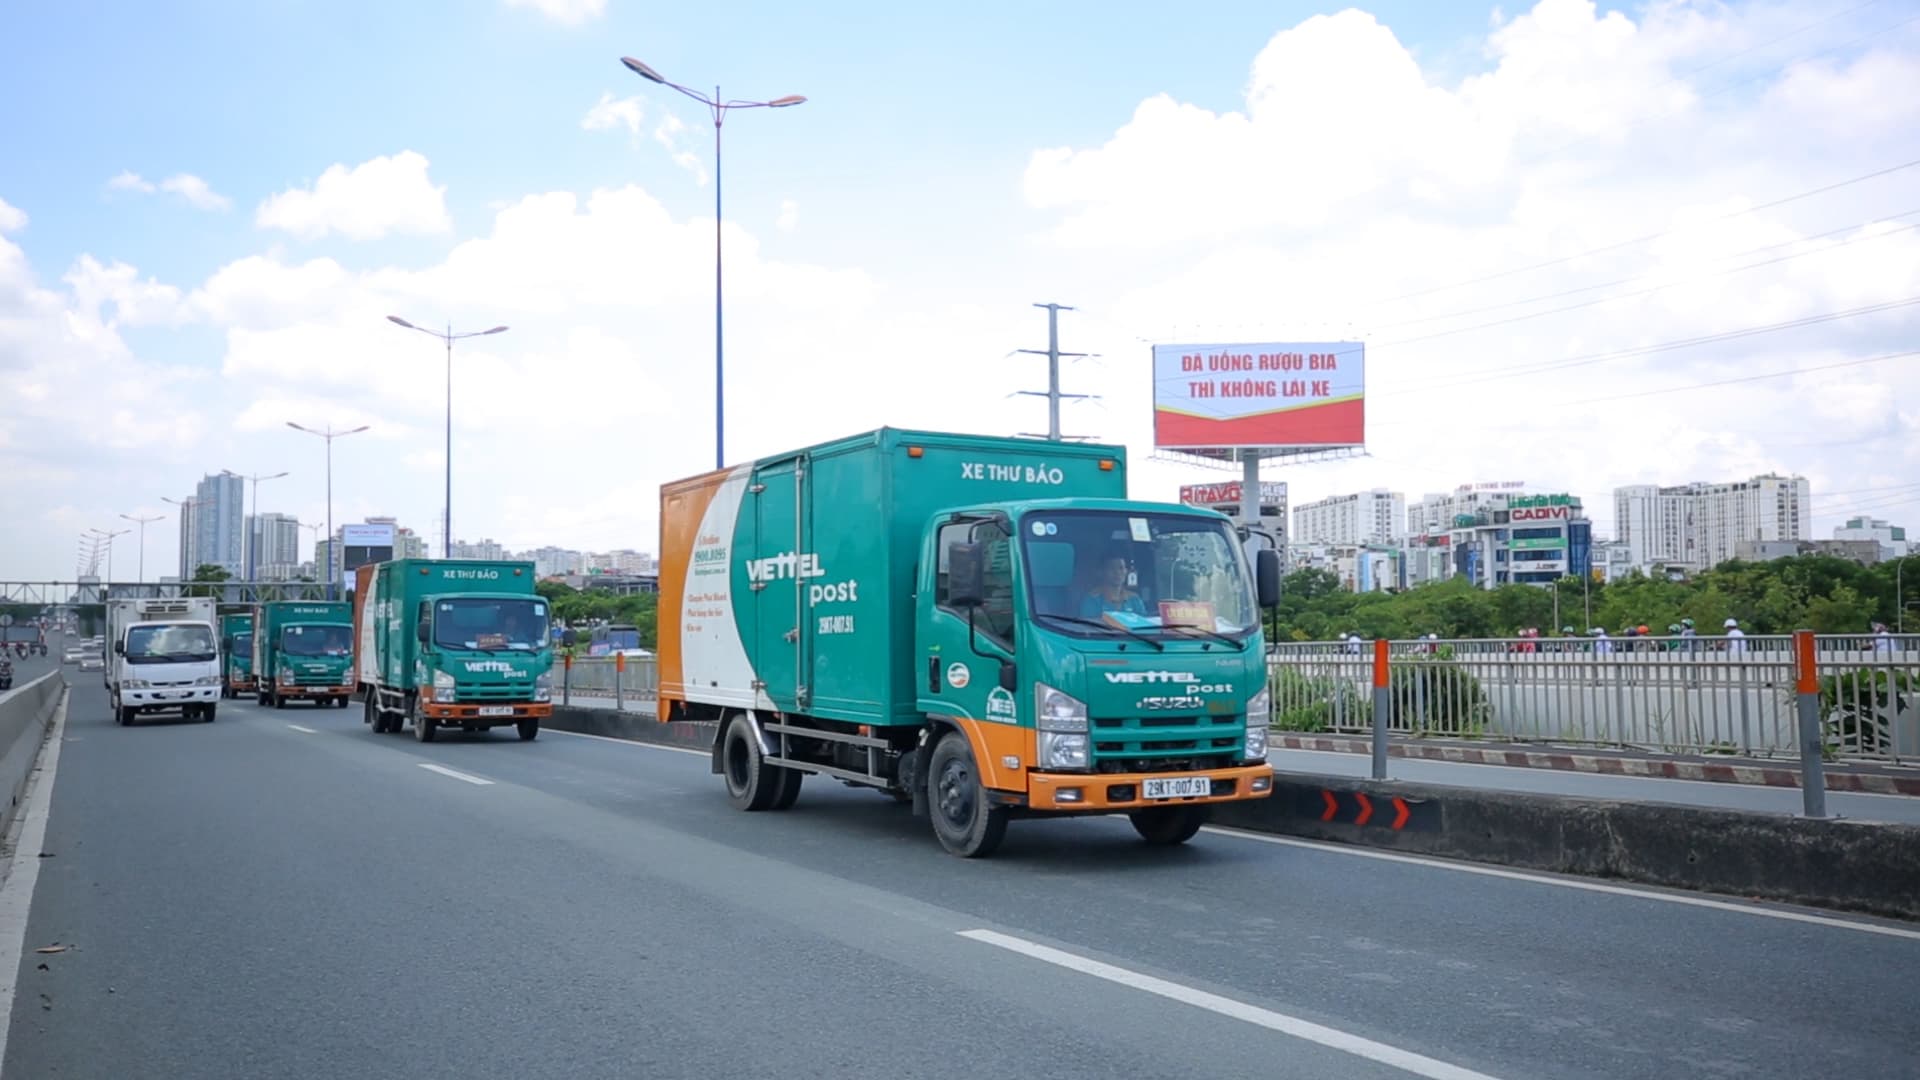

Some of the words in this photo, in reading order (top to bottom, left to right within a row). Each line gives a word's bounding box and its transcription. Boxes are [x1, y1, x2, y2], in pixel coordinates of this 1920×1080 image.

[1182, 353, 1203, 371] ĐÃ
[1209, 350, 1253, 371] UỐNG
[1259, 352, 1303, 372] RƯỢU
[1309, 354, 1336, 370] BIA
[1189, 379, 1215, 398] THÌ
[1220, 379, 1276, 398] KHÔNG
[1282, 380, 1306, 397] LÁI
[1311, 381, 1330, 397] XE
[961, 463, 985, 480] XE
[987, 464, 1021, 482] THƯ
[1025, 463, 1064, 485] BÁO
[1512, 507, 1568, 521] CADIVI
[443, 569, 456, 579] XE
[810, 579, 857, 607] post
[503, 670, 527, 679] post
[1186, 683, 1233, 694] post
[1142, 696, 1200, 709] ISUZU
